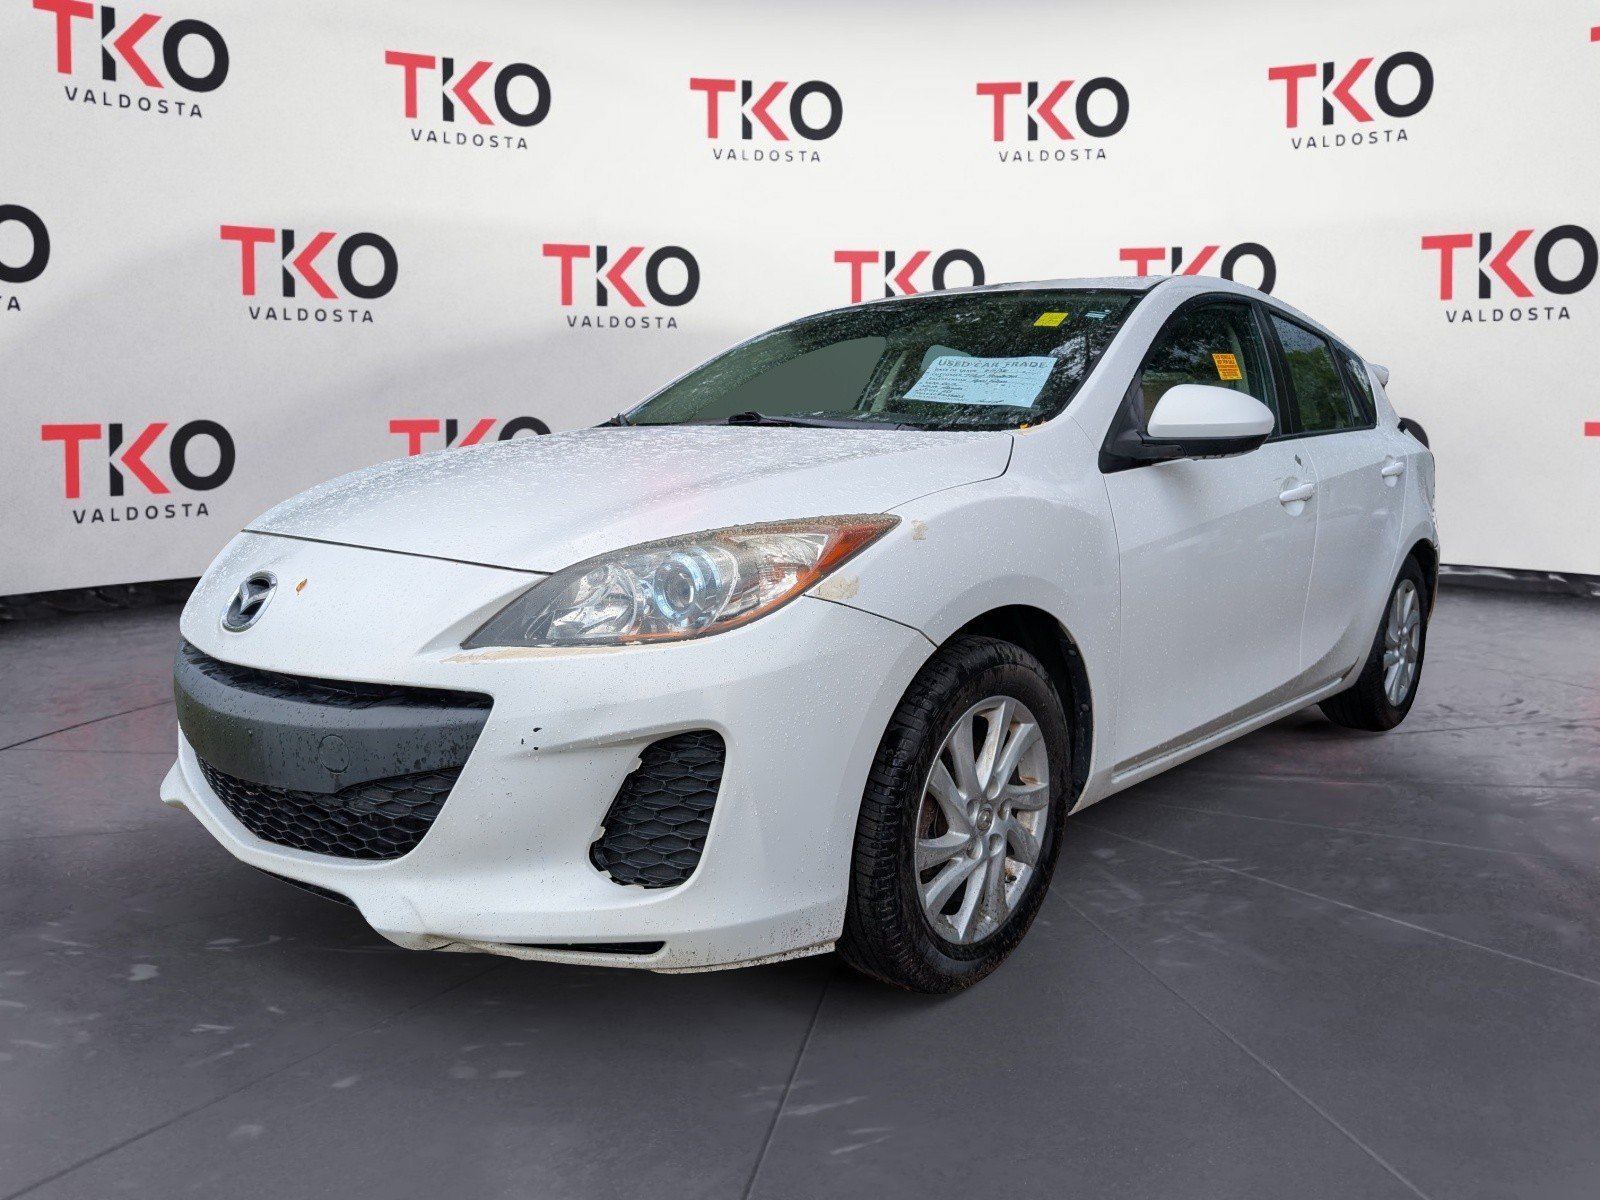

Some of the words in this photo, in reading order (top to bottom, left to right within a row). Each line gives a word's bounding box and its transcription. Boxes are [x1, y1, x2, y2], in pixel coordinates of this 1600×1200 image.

[32, 0, 229, 93] TKO
[64, 86, 202, 118] VALDOSTA
[385, 50, 551, 127] TKO
[690, 78, 843, 141] TKO
[976, 77, 1129, 142] TKO
[1268, 51, 1434, 128] TKO
[411, 129, 527, 149] VALDOSTA
[713, 149, 820, 162] VALDOSTA
[999, 149, 1105, 162] VALDOSTA
[1292, 129, 1407, 149] VALDOSTA
[220, 225, 398, 299] TKO
[542, 244, 700, 307] TKO
[1421, 224, 1600, 301] TKO
[249, 306, 373, 322] VALDOSTA
[567, 316, 677, 329] VALDOSTA
[1446, 307, 1570, 322] VALDOSTA
[41, 420, 235, 499] TKO
[73, 503, 208, 524] VALDOSTA
